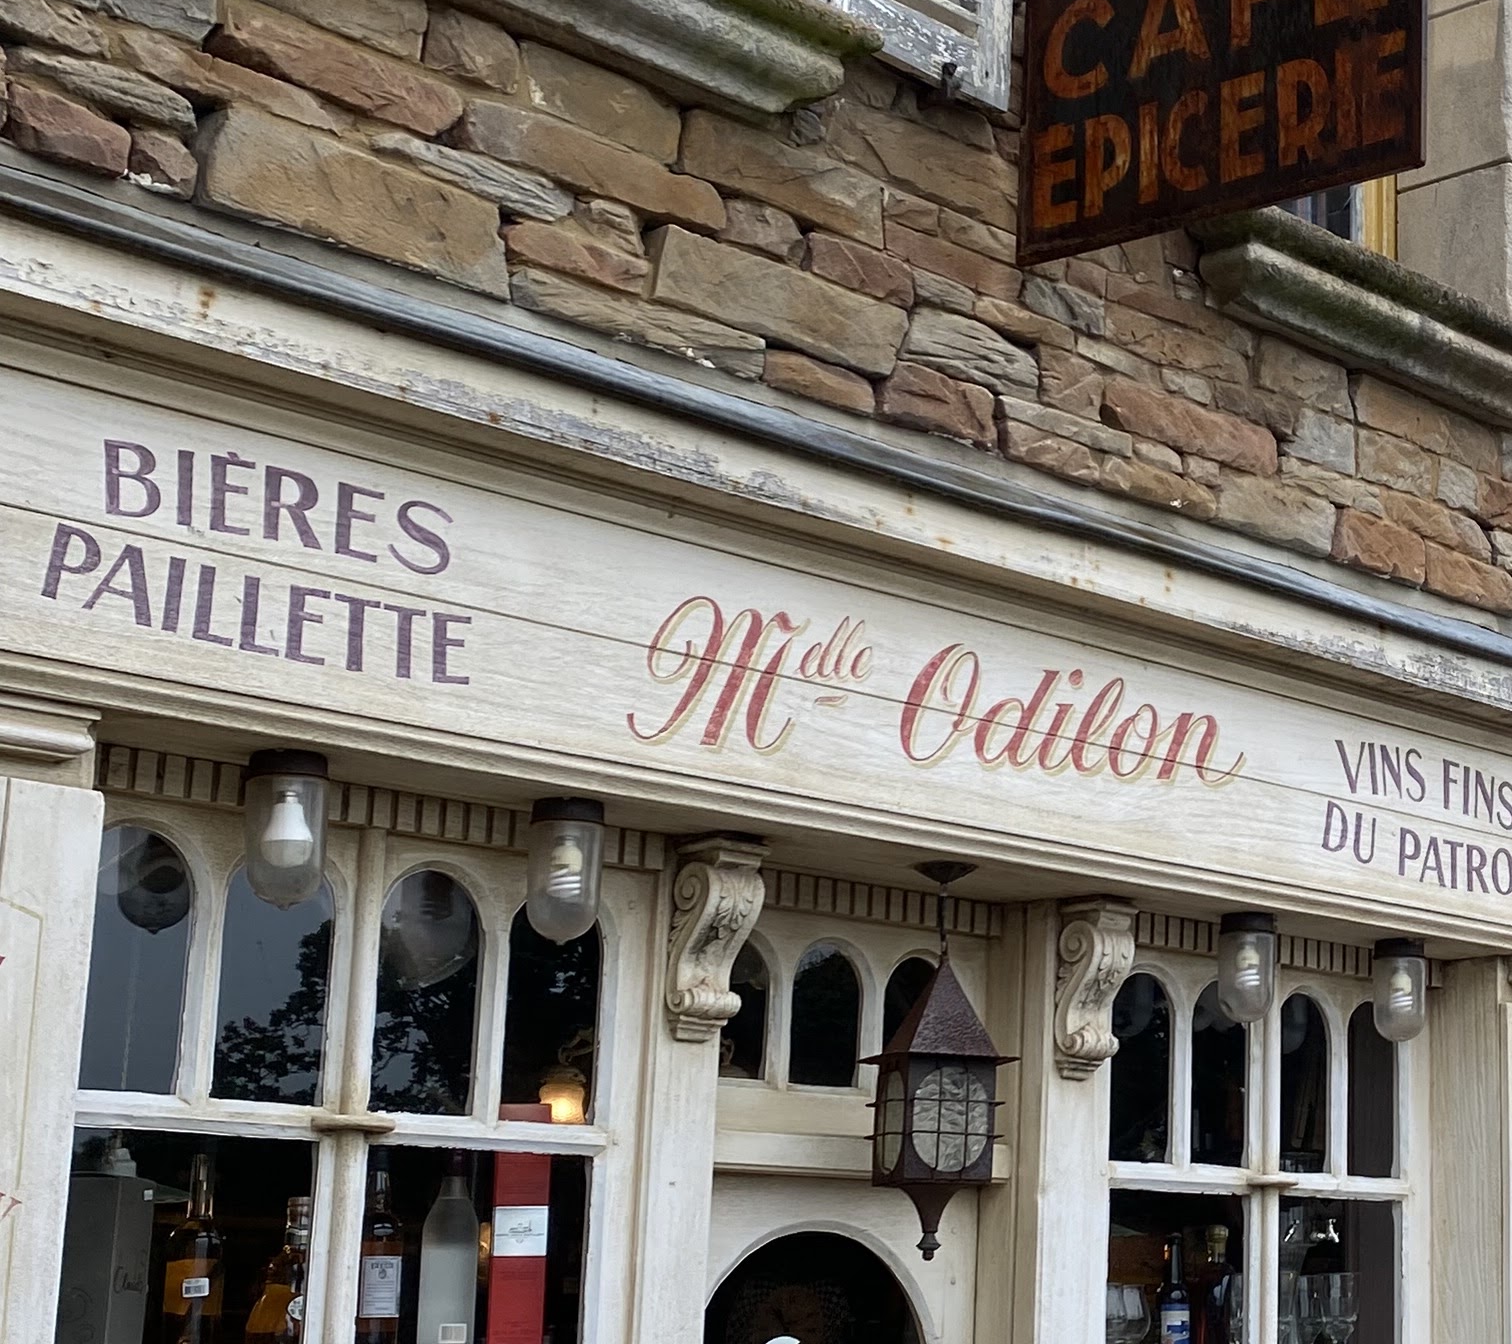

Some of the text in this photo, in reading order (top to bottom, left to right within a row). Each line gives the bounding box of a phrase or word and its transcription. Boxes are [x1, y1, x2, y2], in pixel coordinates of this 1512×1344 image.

[1031, 29, 1407, 228] EPICERIE
[103, 438, 454, 575] BIÈRES
[40, 523, 472, 685] PAILLETTE
[900, 643, 1245, 784] Odilon
[1335, 739, 1426, 803] VINS
[1321, 800, 1377, 864] DU
